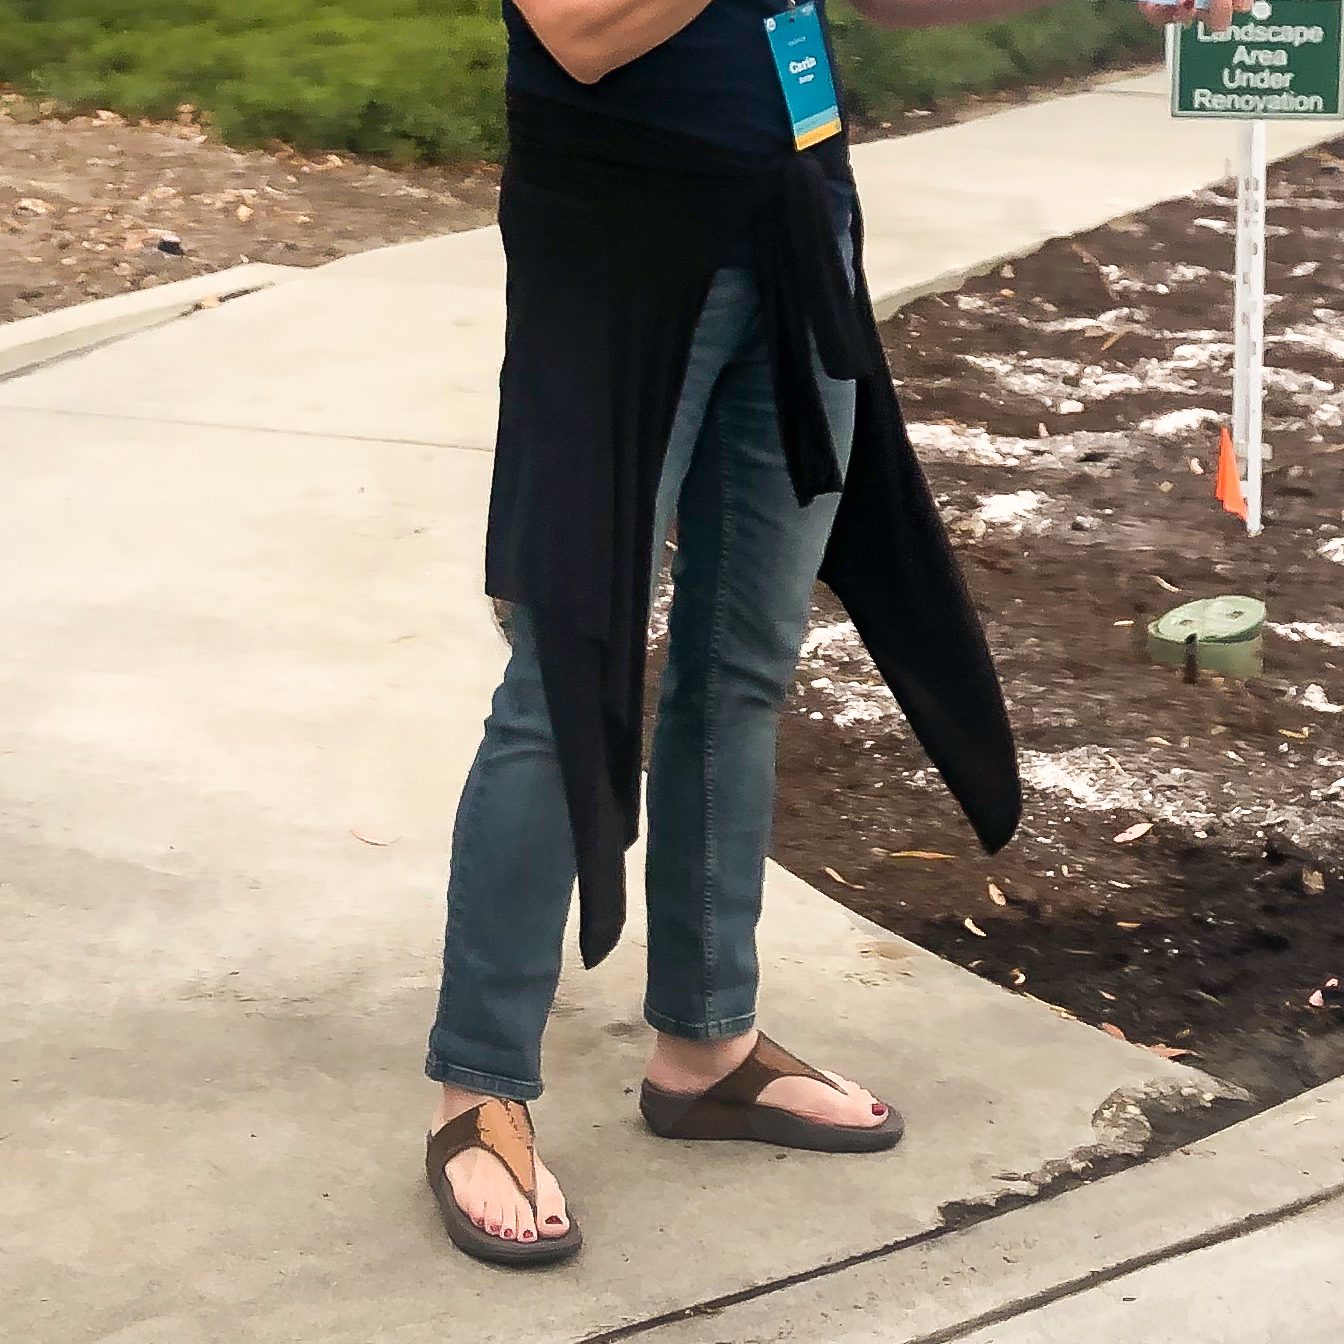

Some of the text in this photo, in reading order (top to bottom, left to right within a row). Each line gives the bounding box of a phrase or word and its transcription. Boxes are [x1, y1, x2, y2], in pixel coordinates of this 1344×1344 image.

[1232, 45, 1288, 66] Area
[1222, 67, 1295, 89] Under
[1192, 88, 1324, 112] Renovation
